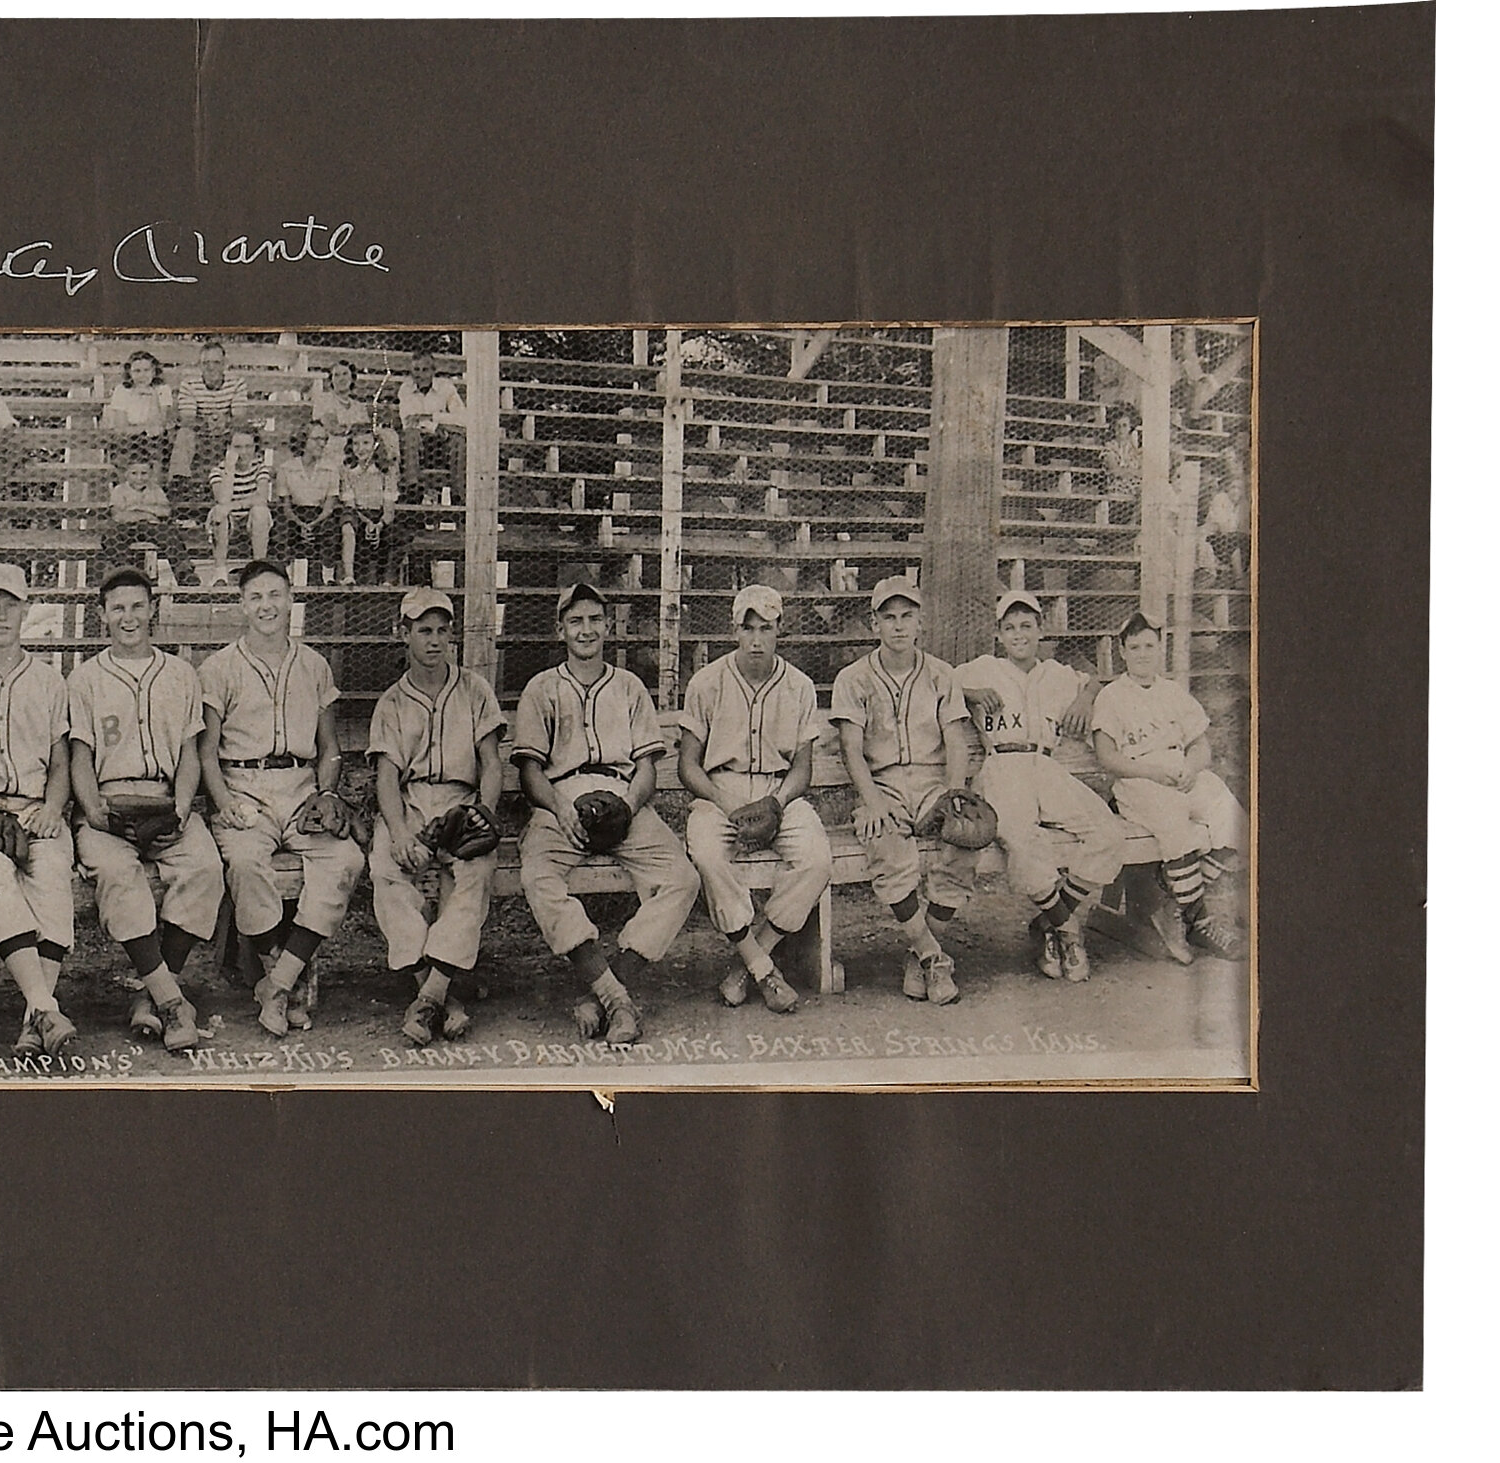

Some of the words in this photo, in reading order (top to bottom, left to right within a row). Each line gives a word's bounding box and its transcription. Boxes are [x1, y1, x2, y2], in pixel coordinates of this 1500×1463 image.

[113, 214, 390, 284] Mantle
[101, 715, 122, 747] B
[182, 1048, 278, 1073] WHIZ
[378, 1044, 504, 1070] BARNEY
[746, 1032, 875, 1060] BAXTER
[884, 1028, 1015, 1057] SPRINGS
